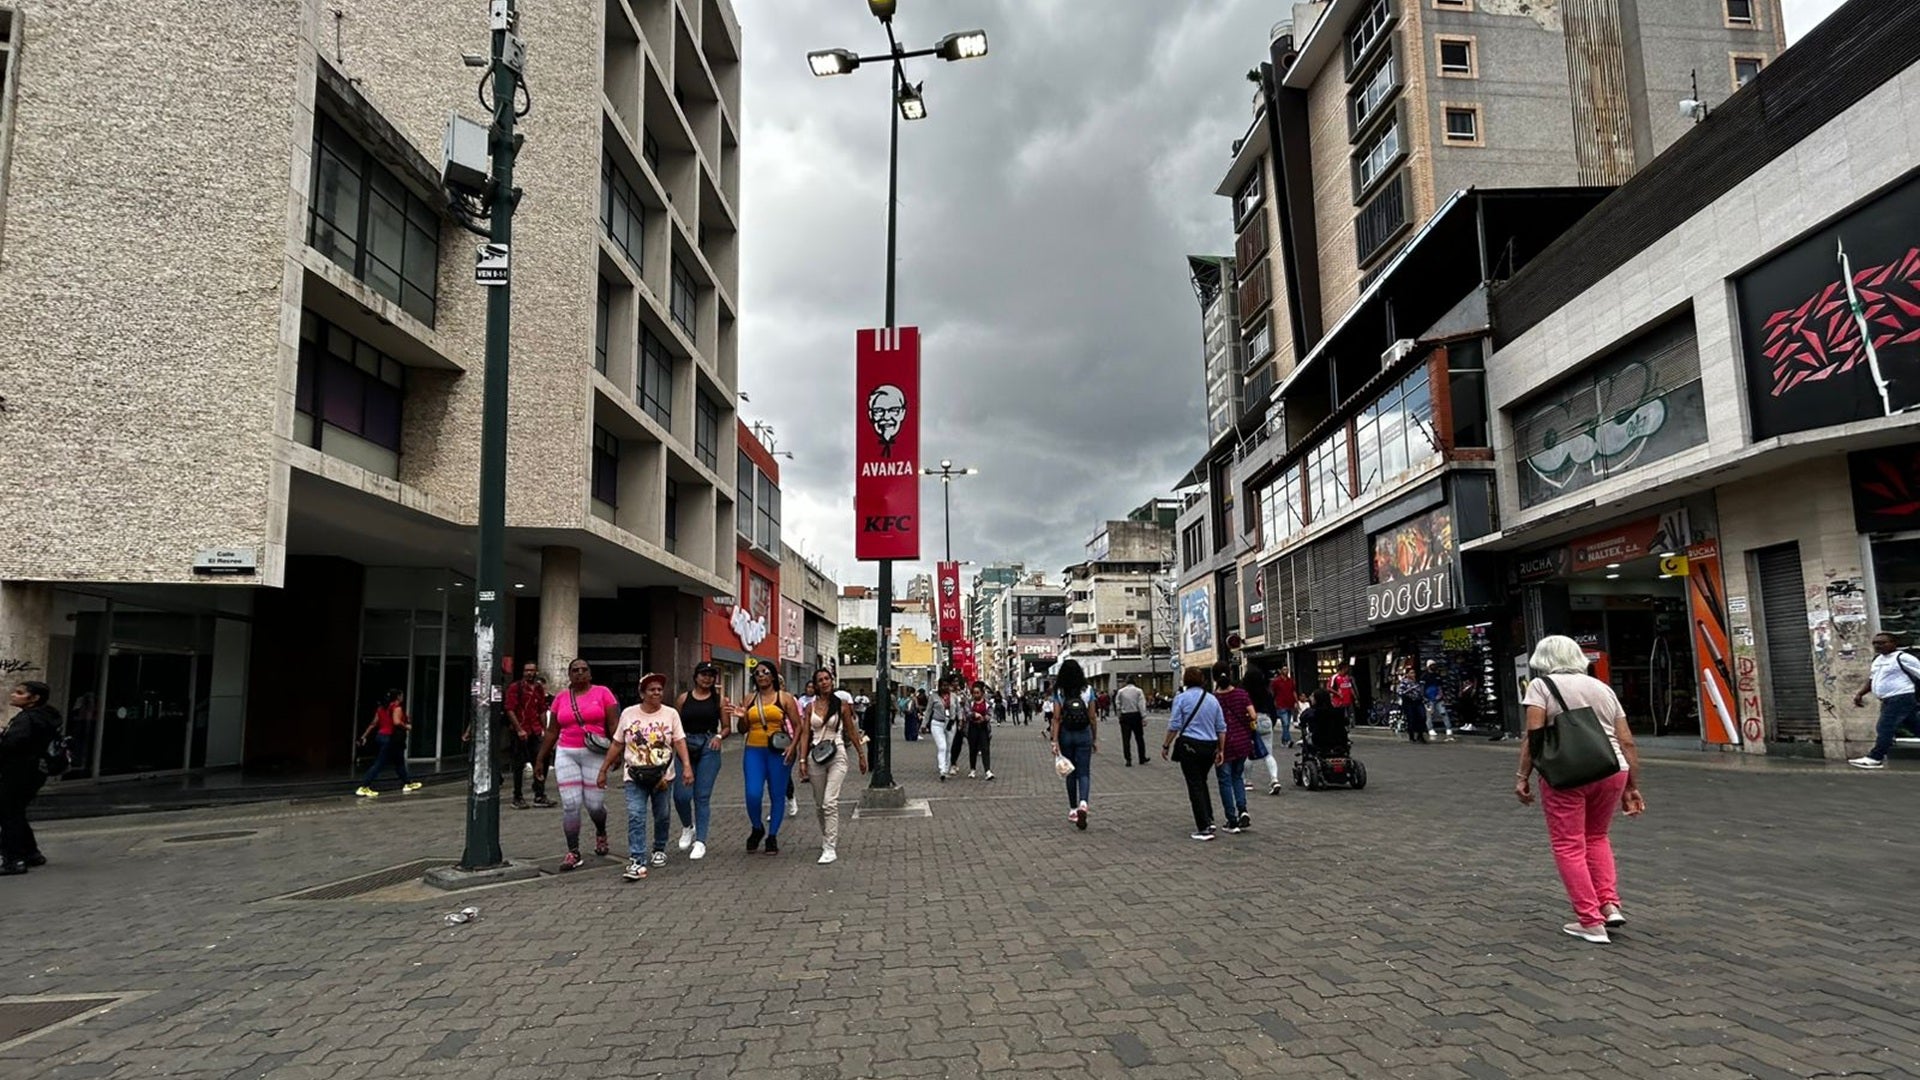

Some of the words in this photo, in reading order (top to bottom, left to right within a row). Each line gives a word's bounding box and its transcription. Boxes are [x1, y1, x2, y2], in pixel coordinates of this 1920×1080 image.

[477, 270, 492, 278] VEN
[862, 460, 913, 477] AVANZA
[864, 515, 911, 533] KFC
[1687, 545, 1716, 557] RUCHA
[1519, 556, 1553, 575] RUCHA
[1368, 572, 1445, 621] BOGGI
[942, 608, 957, 620] NO
[1738, 657, 1762, 742] DEMO
